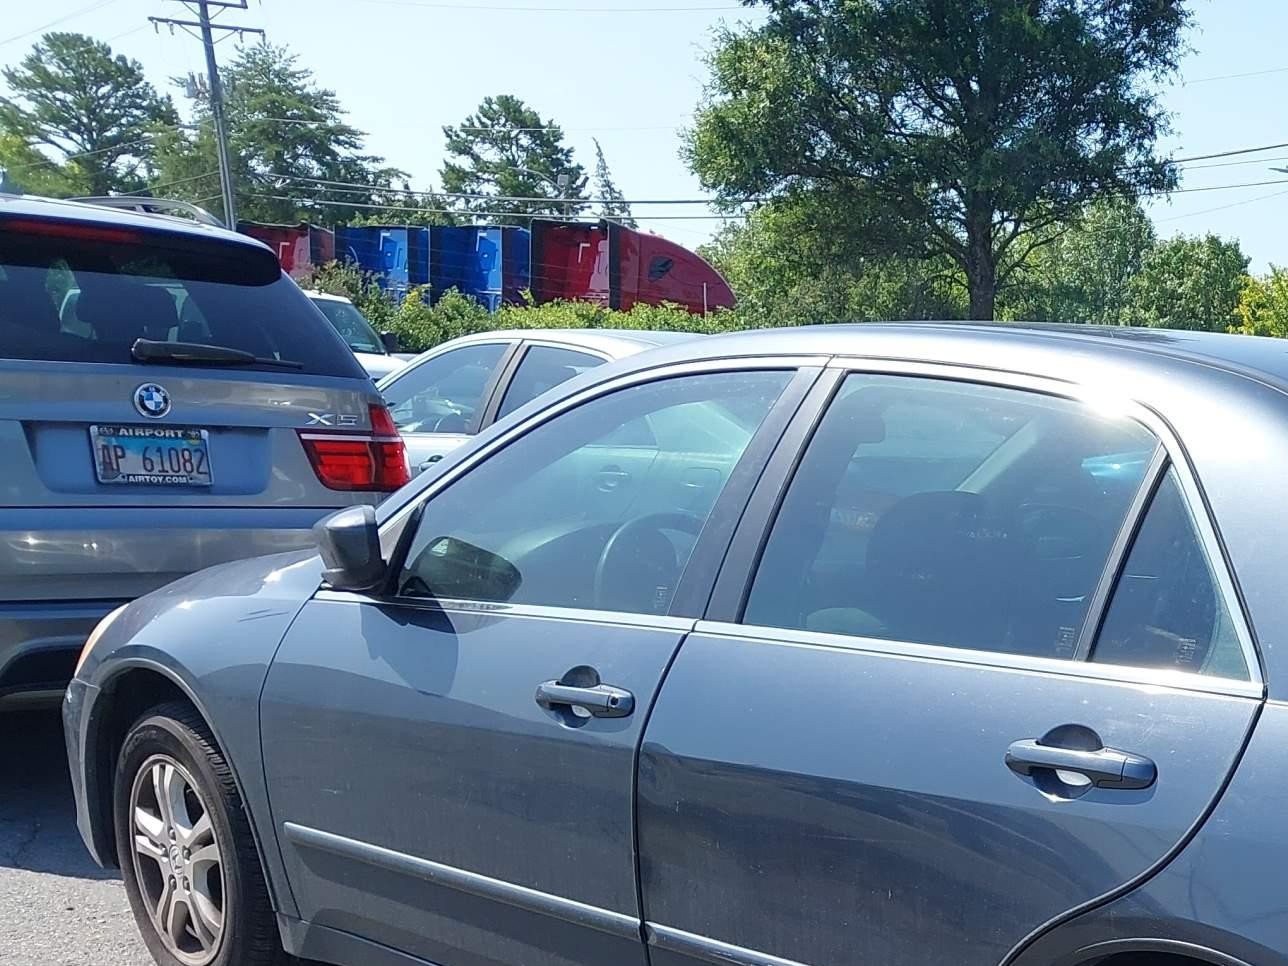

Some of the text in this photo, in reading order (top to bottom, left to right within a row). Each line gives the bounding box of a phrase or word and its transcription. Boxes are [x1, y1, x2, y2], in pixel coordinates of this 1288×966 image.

[305, 412, 358, 426] X5
[118, 428, 184, 438] AIRPORT
[101, 444, 209, 475] AP 61082
[128, 475, 188, 484] AIRTOY.COM
